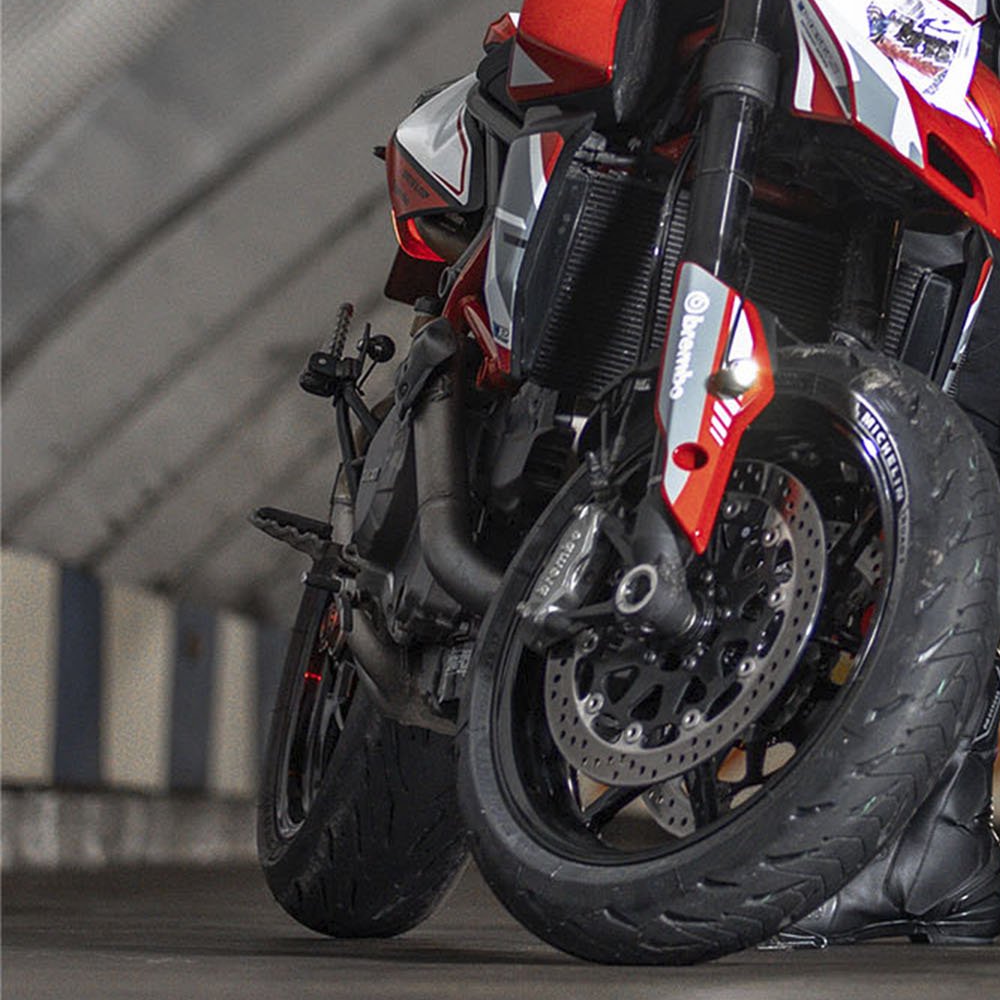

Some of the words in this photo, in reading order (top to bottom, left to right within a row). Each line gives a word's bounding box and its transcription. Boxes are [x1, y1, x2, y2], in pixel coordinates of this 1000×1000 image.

[669, 314, 705, 400] brembo
[860, 410, 905, 502] MICHELIN
[534, 529, 582, 598] brembo
